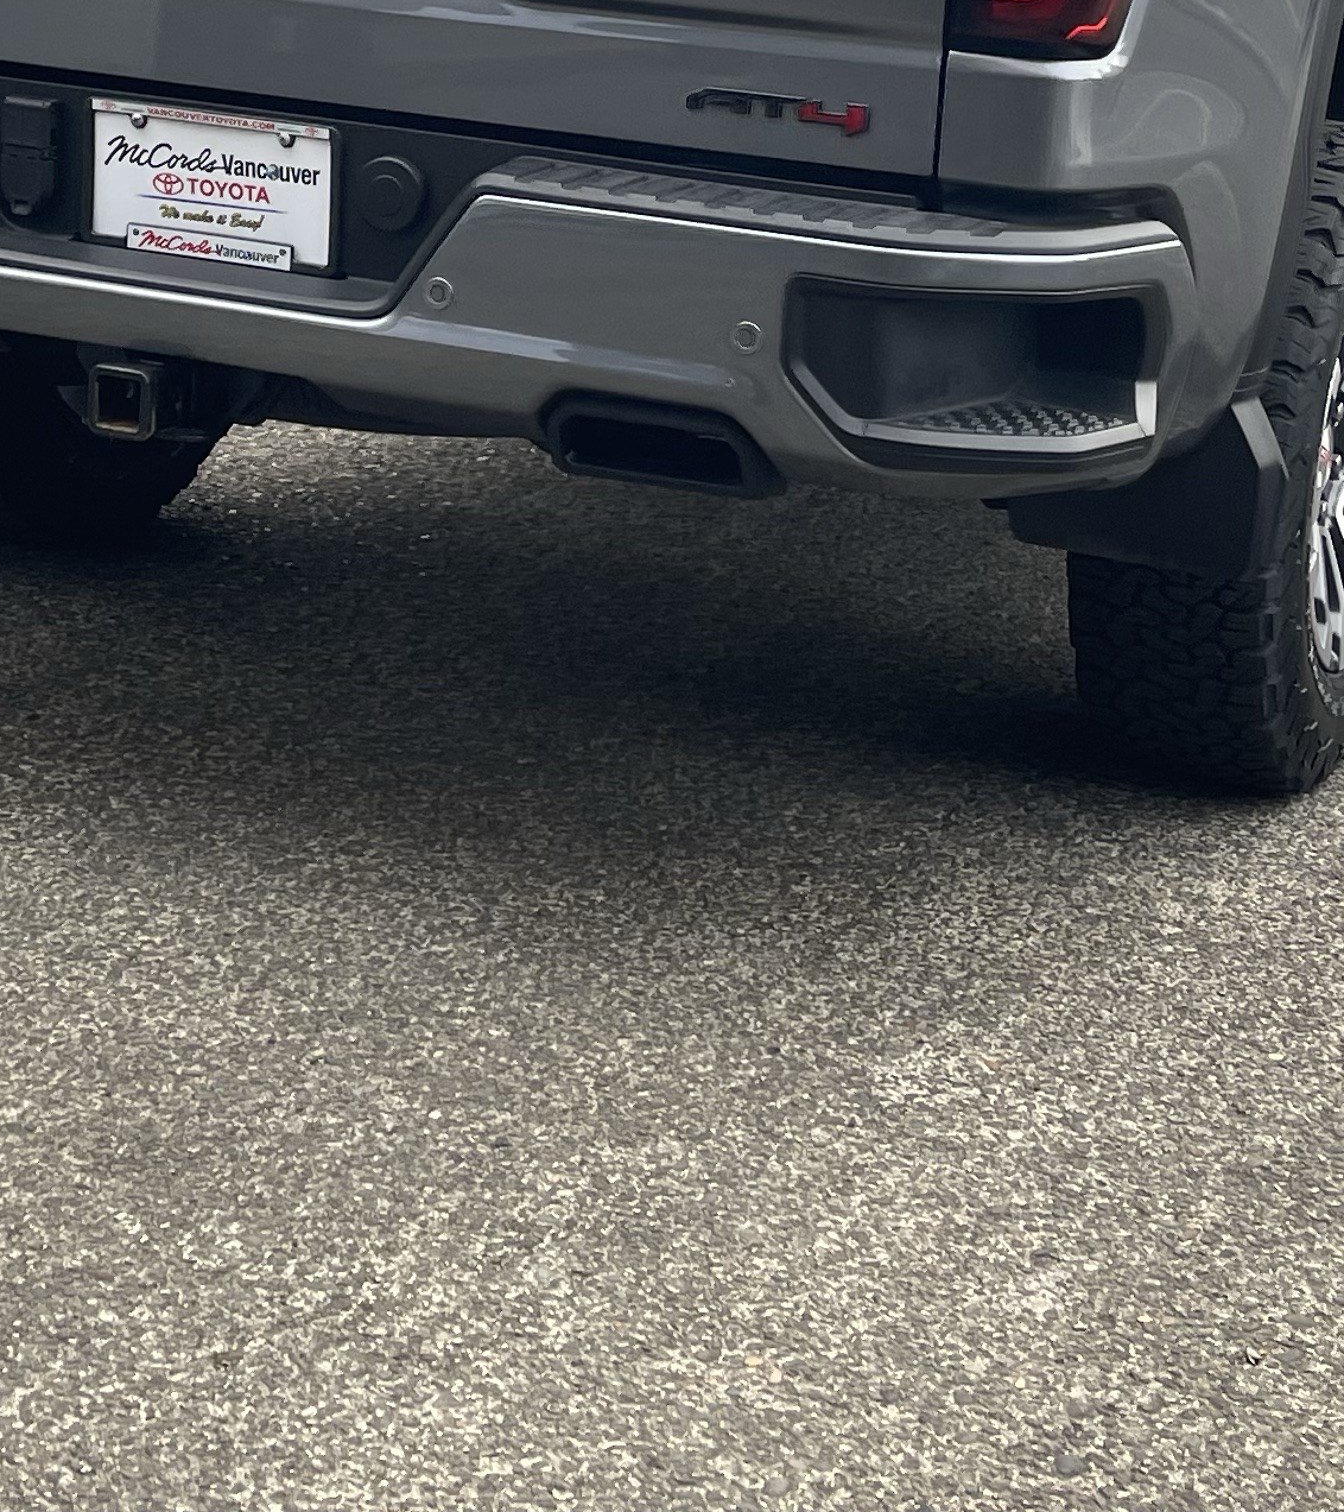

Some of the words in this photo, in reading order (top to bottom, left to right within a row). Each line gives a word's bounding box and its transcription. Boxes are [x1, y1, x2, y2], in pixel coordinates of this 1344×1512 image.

[146, 106, 275, 131] VANCOUVERTOYOTA.COM
[685, 86, 870, 136] AT4
[187, 178, 271, 204] TOYOTA
